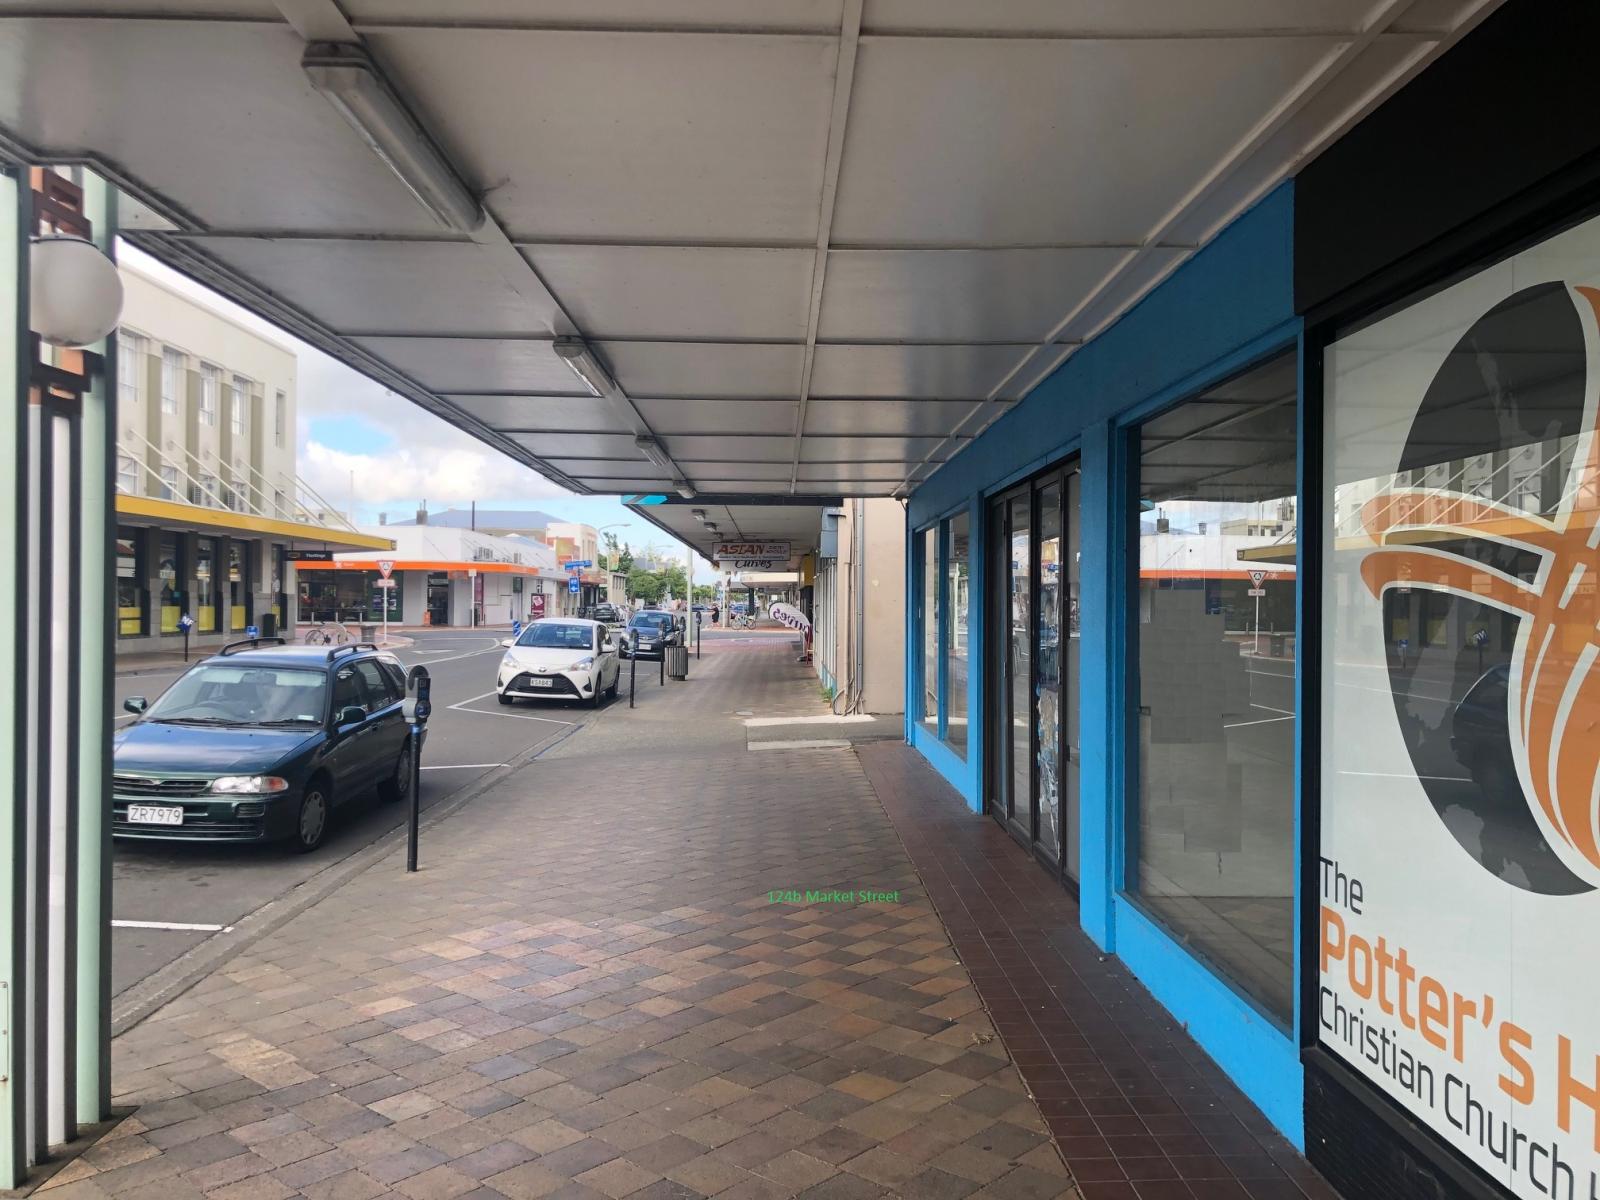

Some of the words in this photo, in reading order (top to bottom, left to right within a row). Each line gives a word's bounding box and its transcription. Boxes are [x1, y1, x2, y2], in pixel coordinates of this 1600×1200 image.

[718, 545, 765, 554] ASIAN
[130, 808, 181, 822] ZR7979
[1320, 857, 1363, 915] The
[1320, 986, 1434, 1108] Christian
[1444, 1073, 1574, 1200] Church
